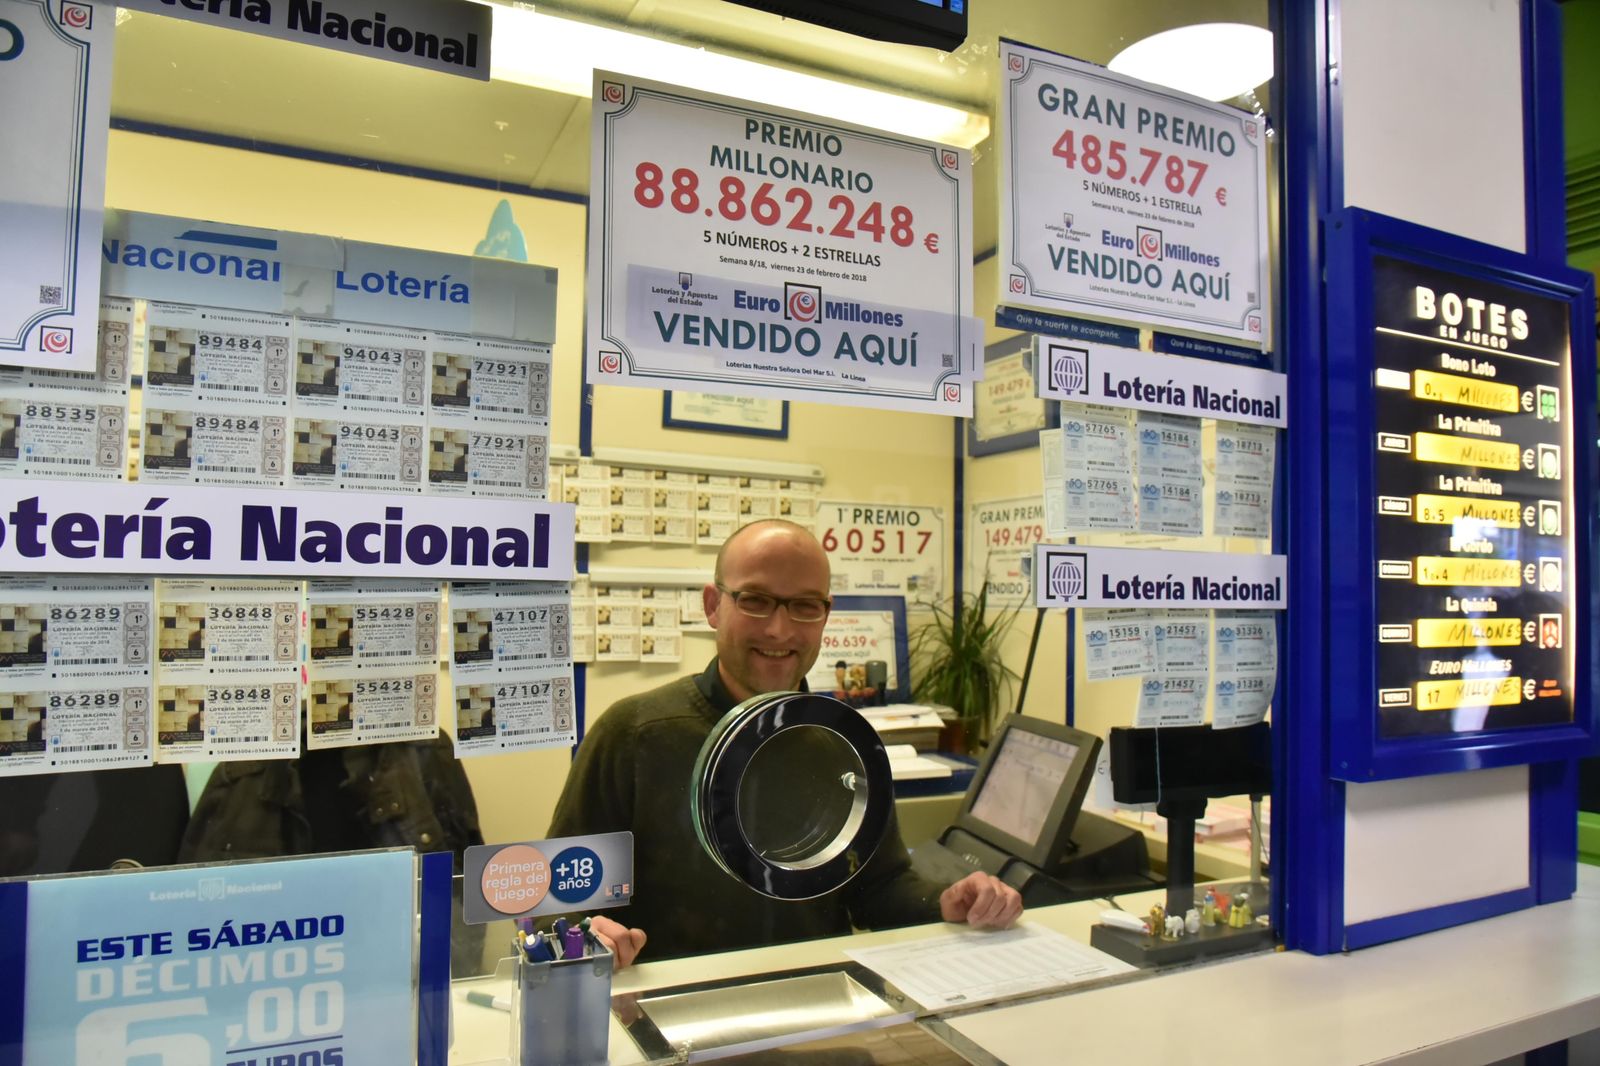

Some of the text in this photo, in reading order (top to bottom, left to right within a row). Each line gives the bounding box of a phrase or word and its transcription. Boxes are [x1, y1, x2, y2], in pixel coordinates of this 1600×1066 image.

[287, 0, 478, 68] Nacional
[1038, 83, 1236, 157] GRAN PREMIO
[745, 118, 842, 156] PREMIO
[709, 145, 873, 193] MILLONARIO
[1052, 129, 1228, 207] 485.787 €
[634, 161, 939, 254] 88.862.248 €
[1082, 180, 1089, 190] 5
[1092, 181, 1141, 203] NÚMEROS
[1151, 196, 1157, 206] 1
[1159, 197, 1202, 216] ESTRELLA
[703, 230, 711, 243] 5
[716, 231, 788, 254] NÚMEROS
[802, 245, 810, 257] 2
[814, 247, 881, 267] ESTRELLAS
[1101, 229, 1220, 268] Euro Millones
[719, 255, 748, 266] Semana
[770, 262, 795, 273] viernes
[806, 267, 815, 275] de
[816, 268, 841, 279] febrero
[842, 271, 850, 280] de
[851, 273, 867, 283] 2018
[1047, 243, 1163, 289] VENDIDO
[1171, 269, 1231, 301] AQUÍ
[336, 270, 470, 304] Lotería
[687, 291, 718, 300] Apuestas
[667, 296, 703, 307] del Estado
[734, 289, 904, 328] Euro Millones
[1016, 313, 1033, 325] Que
[1034, 316, 1043, 326] la
[1044, 319, 1069, 331] suerte
[1070, 323, 1079, 332] te
[1415, 286, 1529, 340] BOTES
[199, 334, 262, 350] 89484
[653, 311, 918, 367] VENDIDO AQUÍ
[1170, 338, 1185, 349] Que
[1439, 325, 1508, 350] EN JUEGO
[344, 347, 402, 363] 94043
[475, 361, 527, 376] 77921
[753, 363, 777, 372] Nuestra
[779, 365, 800, 374] Señora
[801, 367, 812, 375] Del
[1441, 353, 1497, 377] Bono Loto
[1103, 372, 1281, 420] Lotería Nacional
[1521, 391, 1534, 412] €
[26, 405, 96, 421] 88535
[195, 417, 260, 431] 89484
[341, 426, 399, 440] 94043
[1085, 422, 1116, 434] 57765
[1438, 413, 1501, 437] La Primitiva
[472, 435, 525, 449] 77921
[1161, 431, 1190, 442] 14184
[1522, 448, 1535, 470] €
[1087, 479, 1118, 490] 57765
[1162, 485, 1190, 497] 14184
[1439, 475, 1502, 496] La Primitiva
[853, 508, 920, 526] PREMIO
[980, 509, 1010, 524] GRAN
[1523, 506, 1536, 527] €
[240, 504, 550, 569] Nacional
[822, 528, 932, 555] 60517
[985, 525, 1043, 547] 149.479
[1523, 564, 1536, 584] €
[987, 582, 1023, 594] ENDIDO
[1102, 573, 1281, 602] Lotería Nacional
[51, 607, 120, 620] 86289
[209, 607, 272, 619] 36848
[356, 608, 414, 620] 55428
[1446, 597, 1459, 612] La
[495, 610, 548, 622] 47107
[1109, 626, 1140, 638] 15159
[1166, 625, 1196, 635] 21457
[1523, 621, 1536, 642] €
[356, 680, 413, 693] 55428
[497, 683, 550, 697] 47107
[1164, 679, 1195, 690] 21457
[1428, 690, 1440, 704] 17
[1523, 679, 1536, 700] €
[50, 693, 120, 708] 86289
[208, 688, 271, 701] 36848
[489, 860, 545, 876] Primera
[556, 857, 594, 879] +18
[486, 872, 548, 892] regla del
[558, 878, 592, 891] años
[494, 887, 539, 903] juego:
[76, 914, 345, 963] ESTE SÁBADO
[76, 941, 345, 1002] DÉCIMOS
